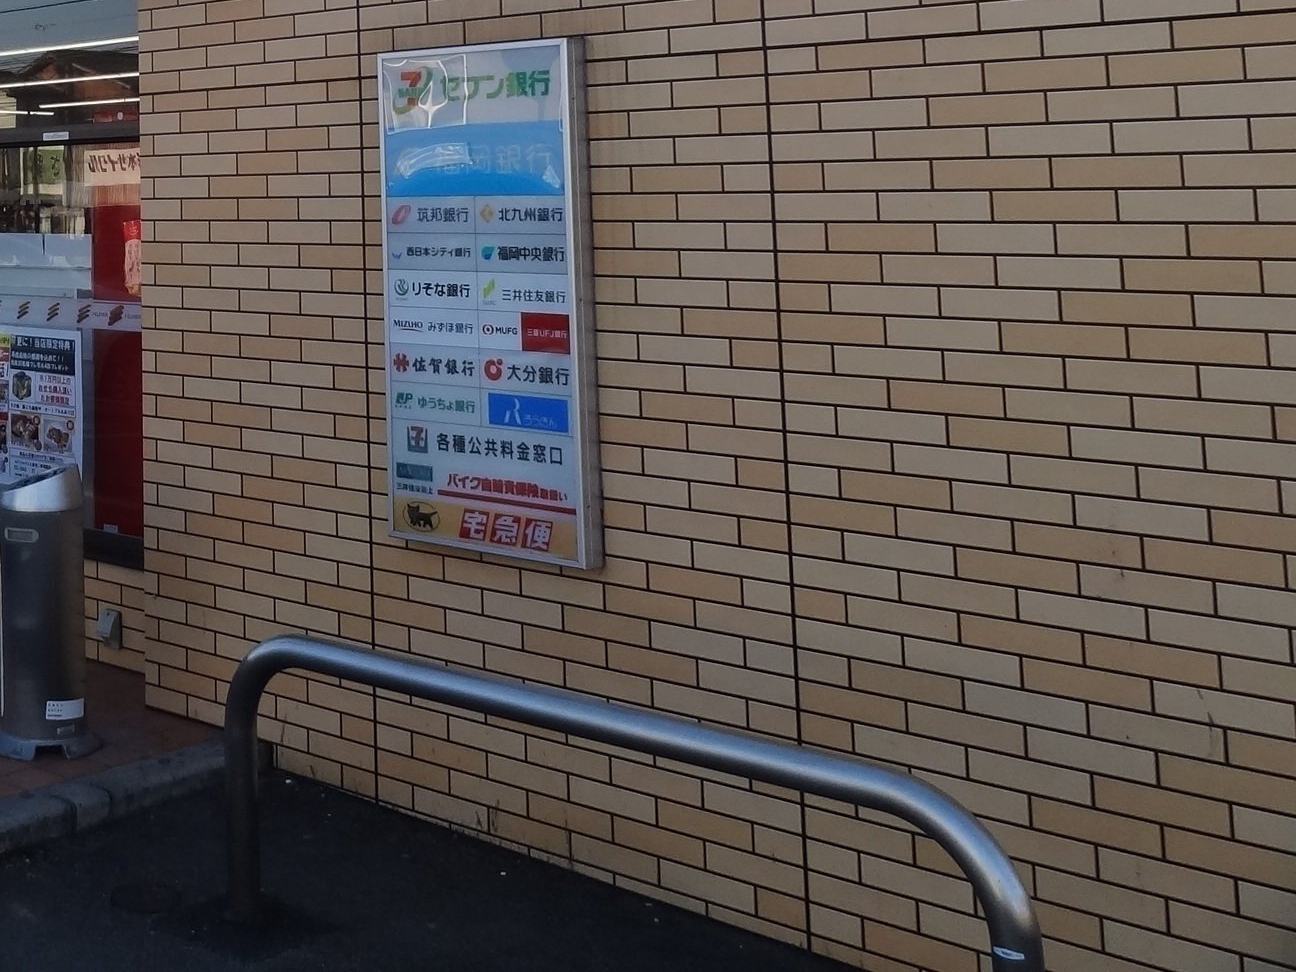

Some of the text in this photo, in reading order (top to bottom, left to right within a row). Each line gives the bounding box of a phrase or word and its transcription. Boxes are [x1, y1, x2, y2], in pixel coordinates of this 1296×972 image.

[440, 69, 551, 100] セブン銀行
[417, 207, 469, 223] 筑邦銀行
[498, 207, 564, 222] 北九州銀行
[406, 247, 471, 258] 西日本シティ銀行
[497, 246, 565, 262] 福岡中央銀行
[411, 282, 471, 298] りそな銀行
[502, 289, 566, 304] 三井住友銀行
[393, 319, 424, 329] MIZUHO
[427, 322, 474, 335] みずほ銀行
[495, 326, 518, 336] MUFG
[527, 329, 568, 339] 三菱UFJ銀行
[412, 357, 475, 377] 佐賀銀行
[507, 364, 570, 386] 大分銀行
[417, 396, 476, 414] ゆうちょ銀行
[436, 432, 563, 466] 各種公共料金窓口
[461, 509, 551, 551] 宅急便
